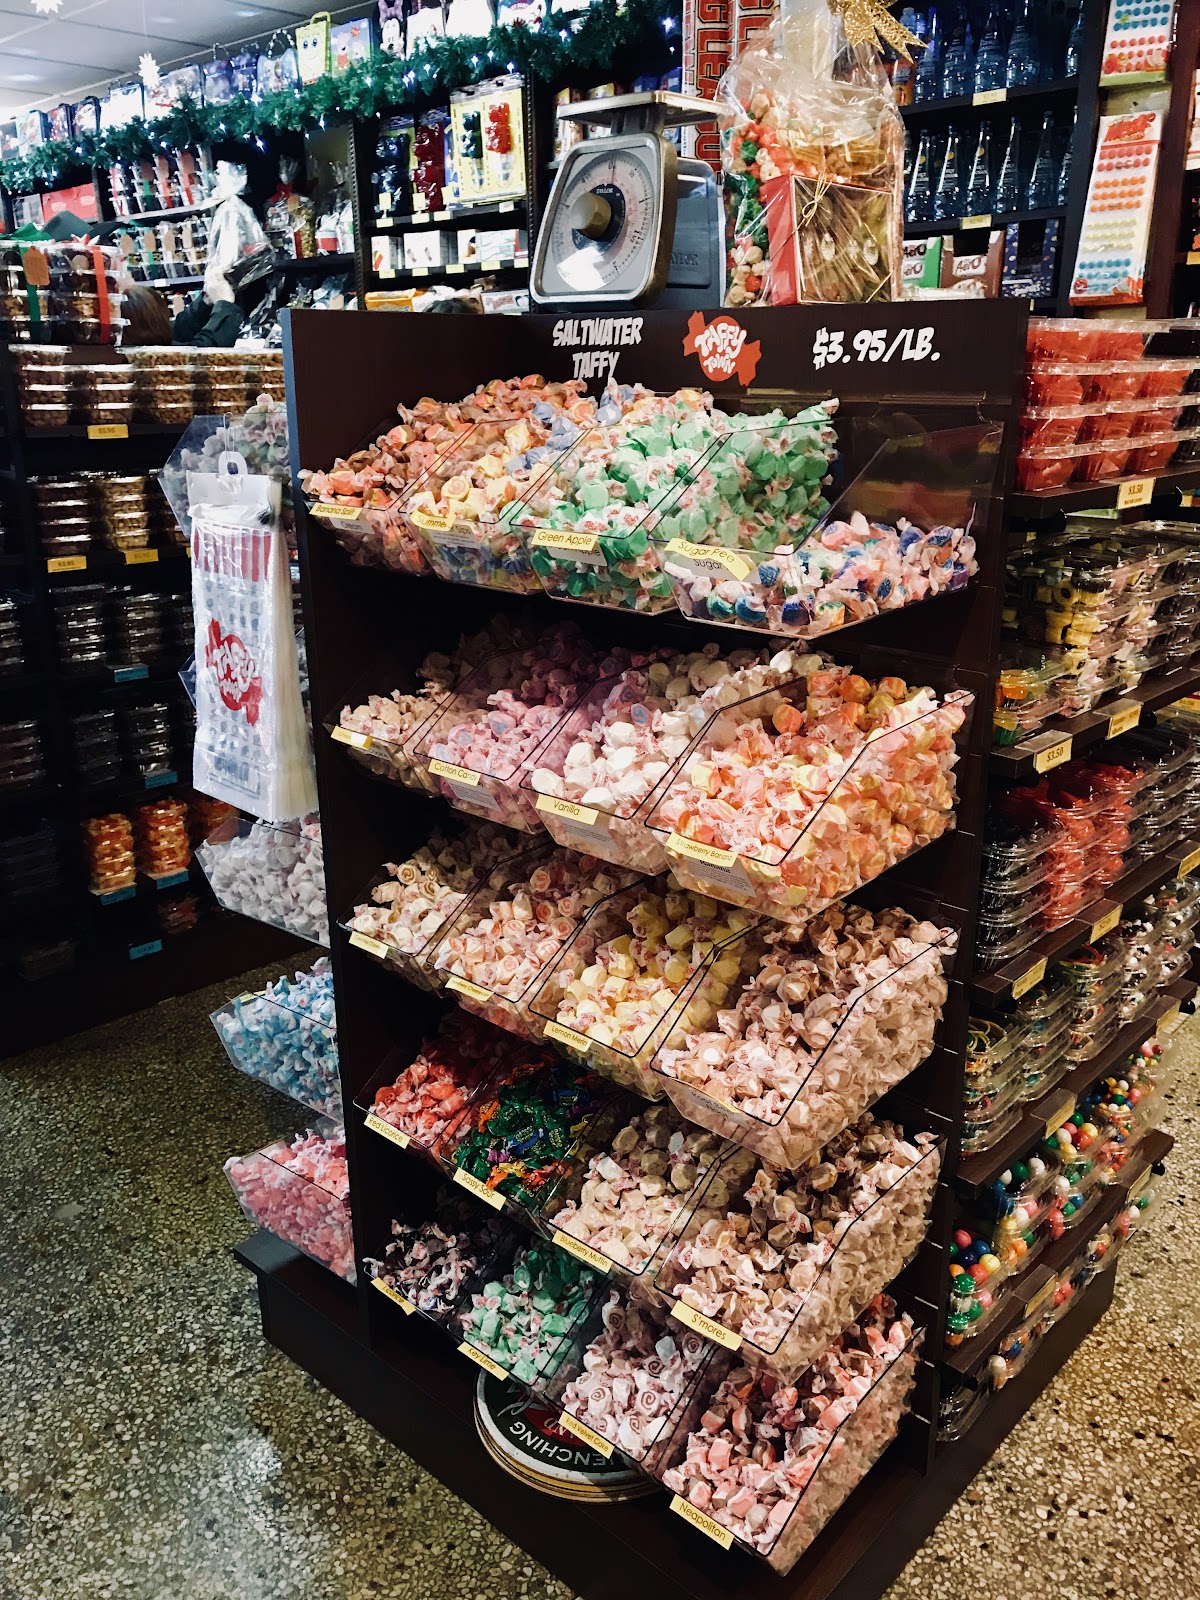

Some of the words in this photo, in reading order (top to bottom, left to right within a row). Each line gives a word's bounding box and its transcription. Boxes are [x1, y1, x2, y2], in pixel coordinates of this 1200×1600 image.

[552, 317, 644, 346] SALTWATER
[694, 322, 747, 359] TAFFY
[812, 327, 941, 370] $3.95/LB.
[572, 350, 620, 380] TAFFY
[703, 353, 736, 374] TOWN
[417, 513, 451, 529] Summe
[537, 531, 565, 544] Green
[566, 534, 593, 548] Apple
[678, 541, 710, 556] Sugar
[1046, 746, 1064, 763] $3.50
[434, 762, 458, 777] Cotton
[457, 769, 478, 783] Candy
[554, 800, 580, 816] Vanilla
[675, 838, 710, 857] Strawberry
[551, 1025, 572, 1041] Lemon
[368, 1117, 381, 1129] Red
[380, 1124, 403, 1143] Licorice
[461, 1173, 480, 1191] Sassy
[480, 1184, 496, 1199] Sour
[559, 1234, 589, 1258] Blueberry
[588, 1251, 608, 1268] Muffin
[691, 1313, 727, 1340] S'mores
[467, 1347, 480, 1362] Key
[479, 1354, 497, 1370] Lime
[509, 1421, 614, 1466] ENCHING
[565, 1417, 578, 1430] Red
[577, 1425, 594, 1443] Velvet
[593, 1436, 609, 1452] Cake
[679, 1502, 726, 1541] Neapolitan
